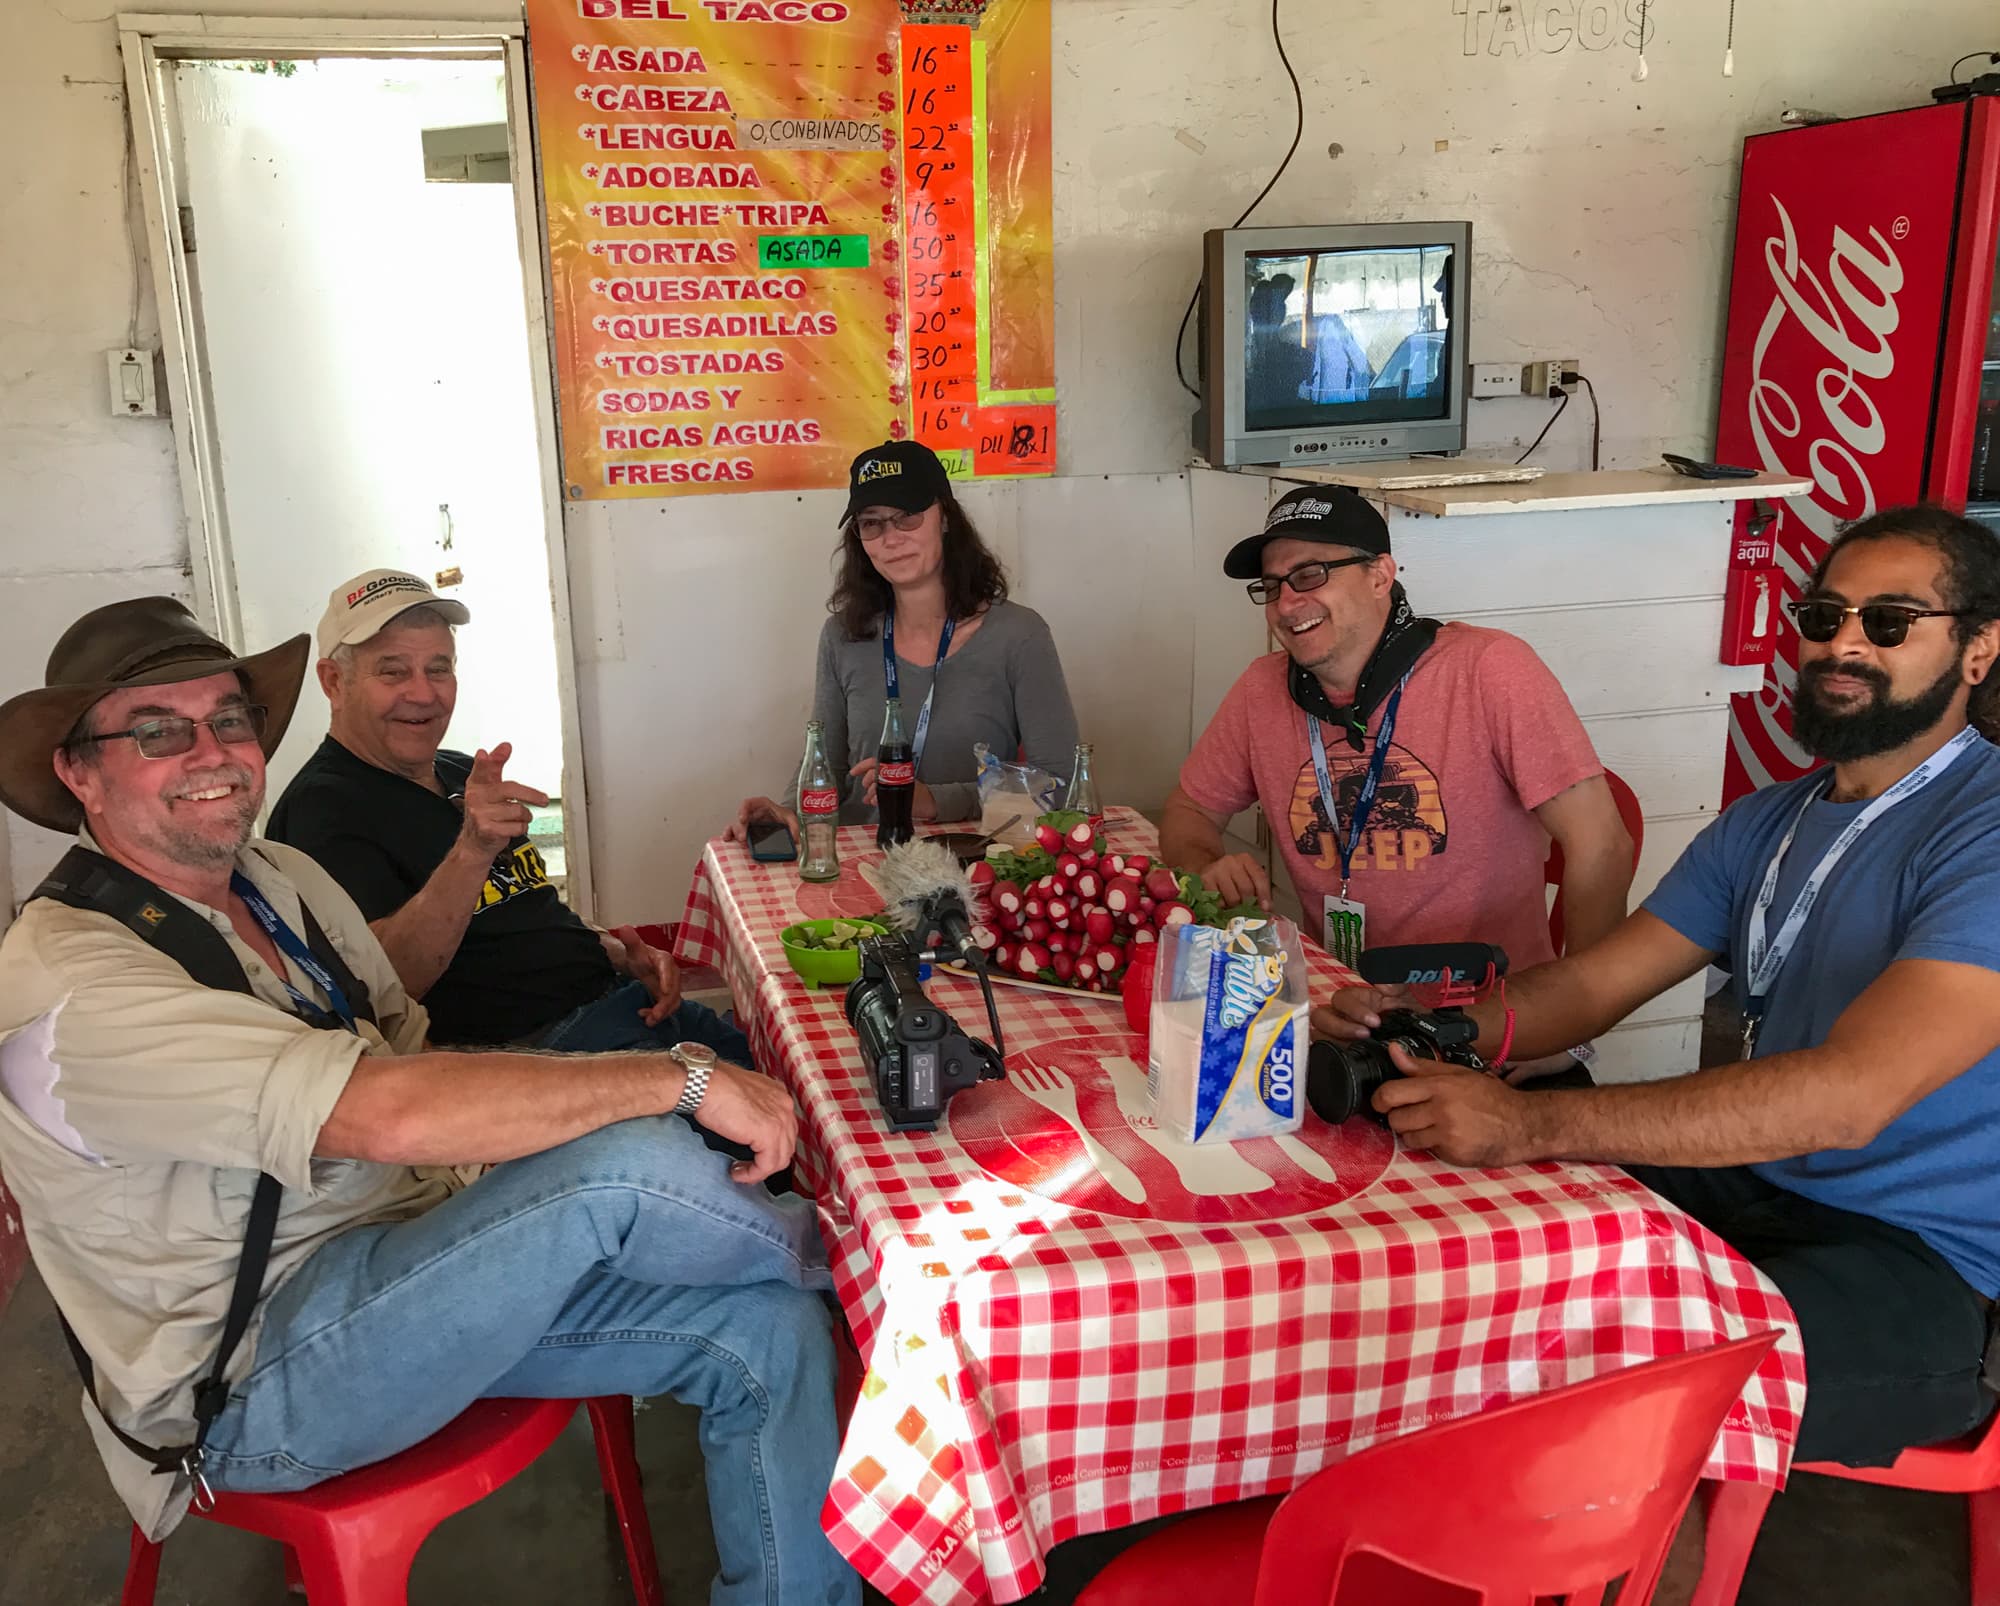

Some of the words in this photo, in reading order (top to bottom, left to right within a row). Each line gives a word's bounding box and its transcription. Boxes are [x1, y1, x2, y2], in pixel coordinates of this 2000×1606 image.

[582, 0, 686, 20] DEL
[704, 1, 848, 22] TACO
[1453, 0, 1655, 56] TACOS
[593, 50, 707, 72] ASADA
[597, 89, 731, 112] CABEZA
[600, 128, 736, 150] LENGUA
[602, 167, 761, 188] ADOBADA
[608, 242, 737, 263] TORTAS
[766, 238, 842, 261] ASADA
[611, 279, 806, 302] QUESATACO
[613, 315, 837, 339] QUESADILLAS
[616, 352, 784, 376] TOSTADAS
[1749, 193, 1904, 545] Cola
[603, 390, 710, 413] SODAS
[722, 390, 741, 409] Y
[607, 427, 702, 449] RICAS
[714, 422, 820, 445] AGUAS
[609, 461, 753, 485] FRESCAS
[881, 464, 900, 475] AEV
[803, 794, 837, 808] Coca-Cola
[1405, 970, 1465, 983] RØE
[1271, 1048, 1293, 1101] 500
[920, 1535, 959, 1578] HOLA
